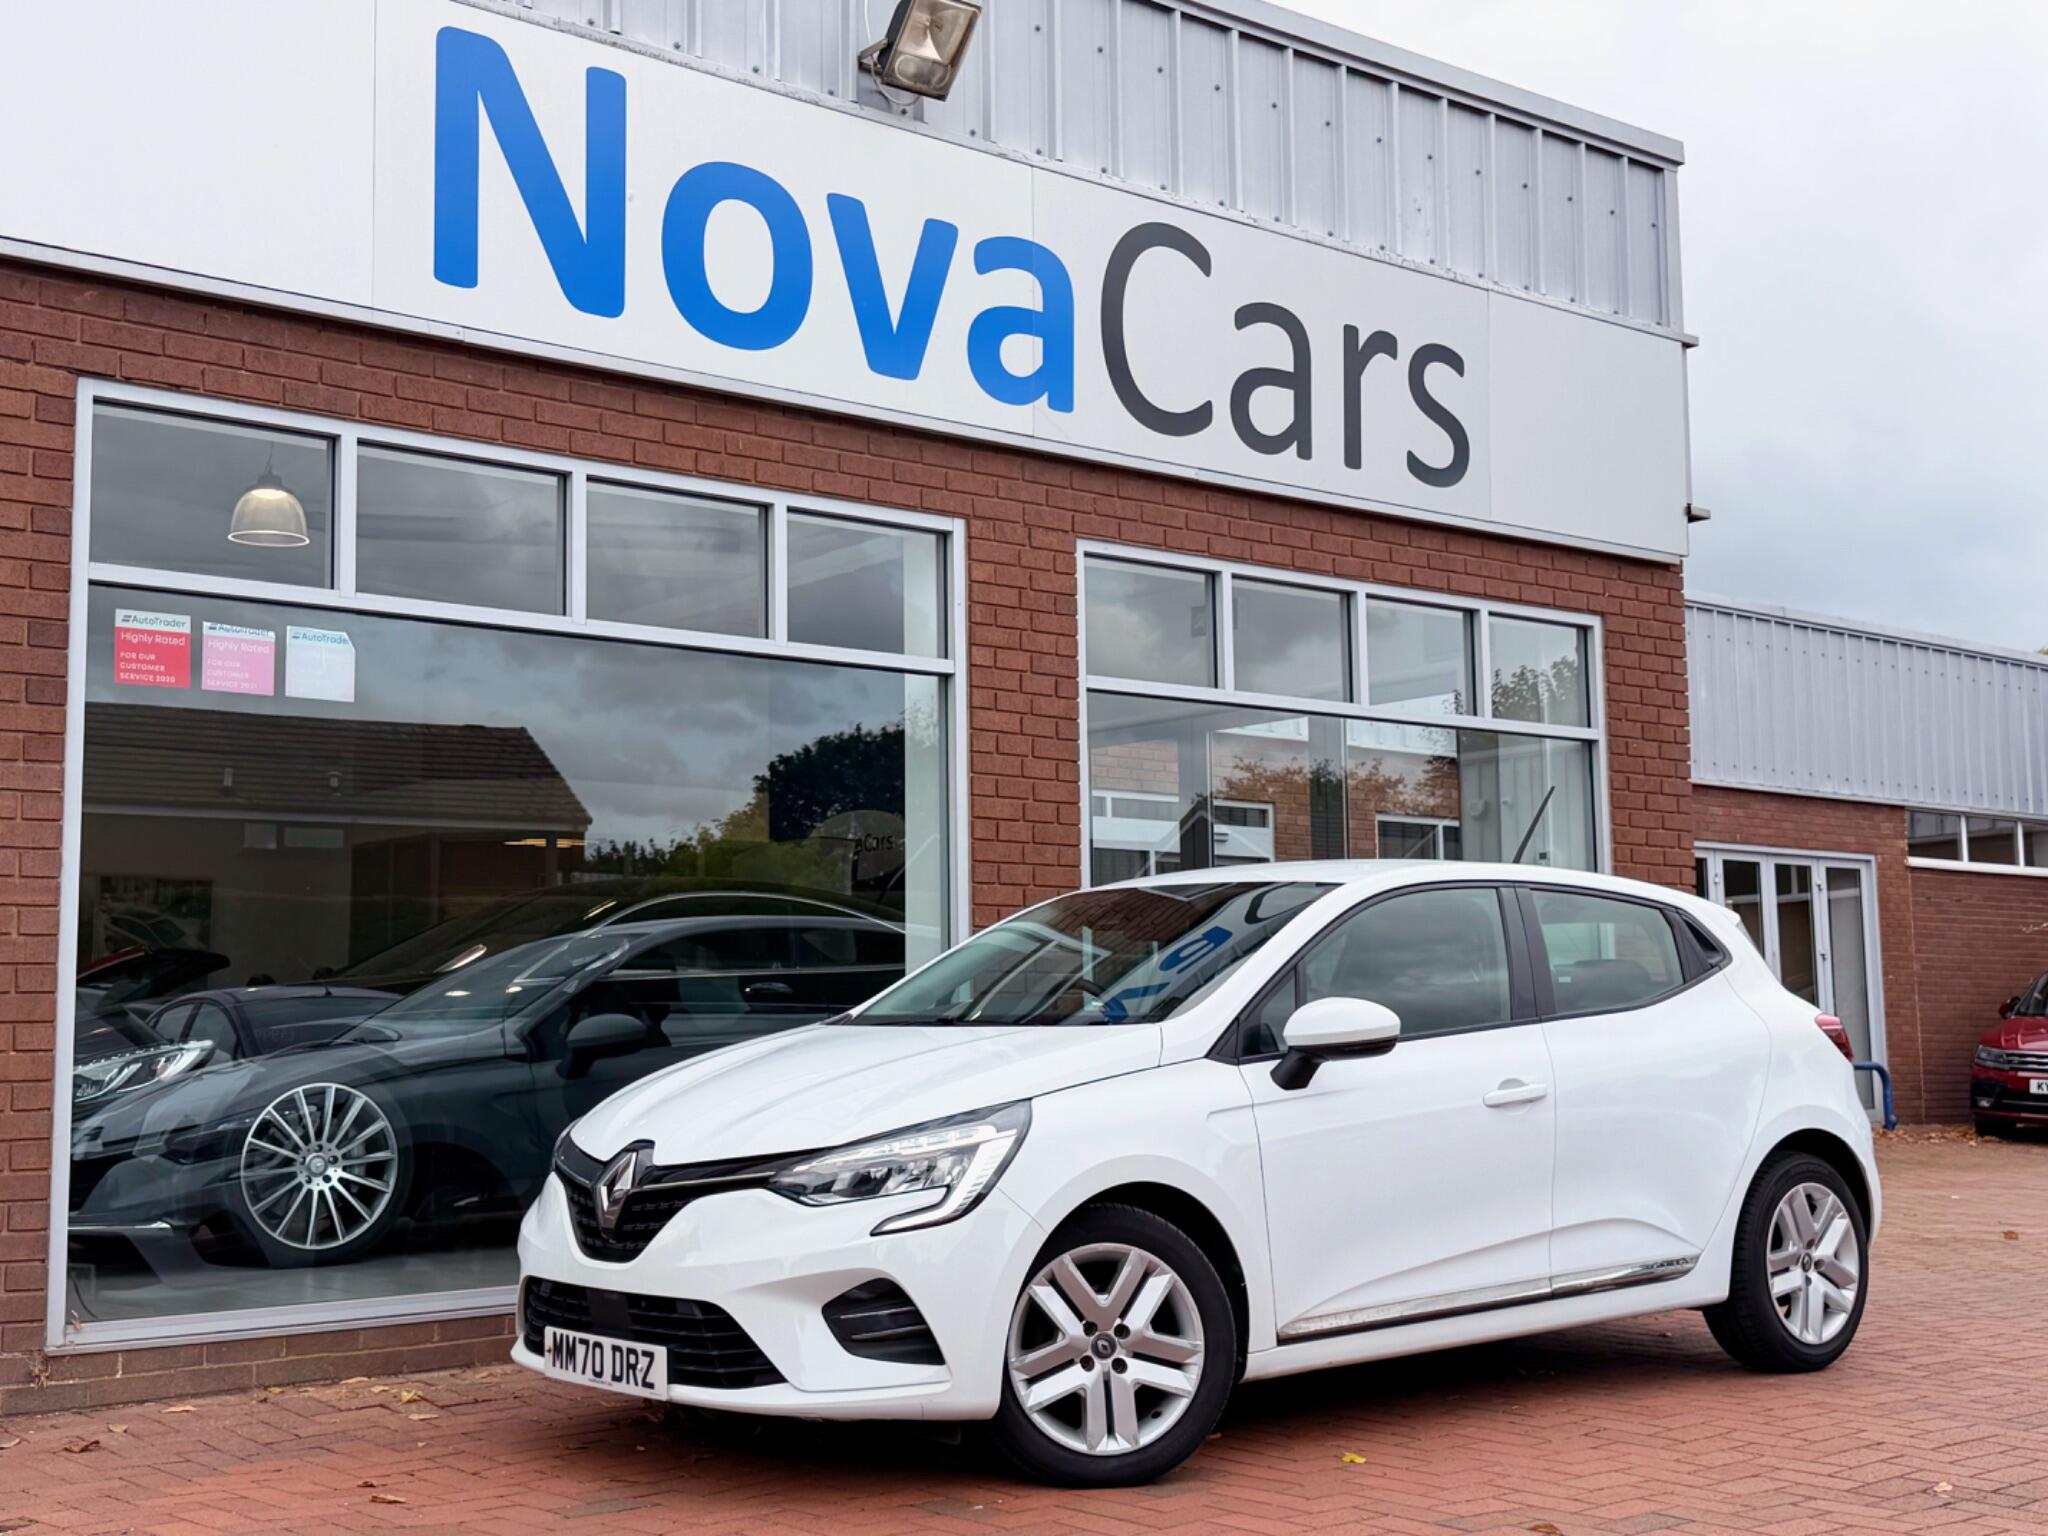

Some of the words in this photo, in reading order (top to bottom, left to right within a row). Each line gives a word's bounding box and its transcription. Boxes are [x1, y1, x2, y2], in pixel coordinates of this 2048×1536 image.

[433, 26, 1471, 487] NovaCars
[131, 614, 187, 628] AutoTrader
[121, 631, 153, 644] Highly
[155, 634, 186, 646] Rated
[301, 632, 349, 645] AutoTrade
[207, 639, 239, 652] Highly
[240, 642, 270, 654] Rated
[120, 651, 137, 659] FOR
[120, 662, 166, 672] CUSTOMER
[120, 672, 154, 682] SERVICE
[155, 675, 176, 683] 2020
[207, 669, 249, 679] CUSTOMER
[552, 1331, 605, 1379] MM70
[611, 1344, 656, 1390] DRZ
